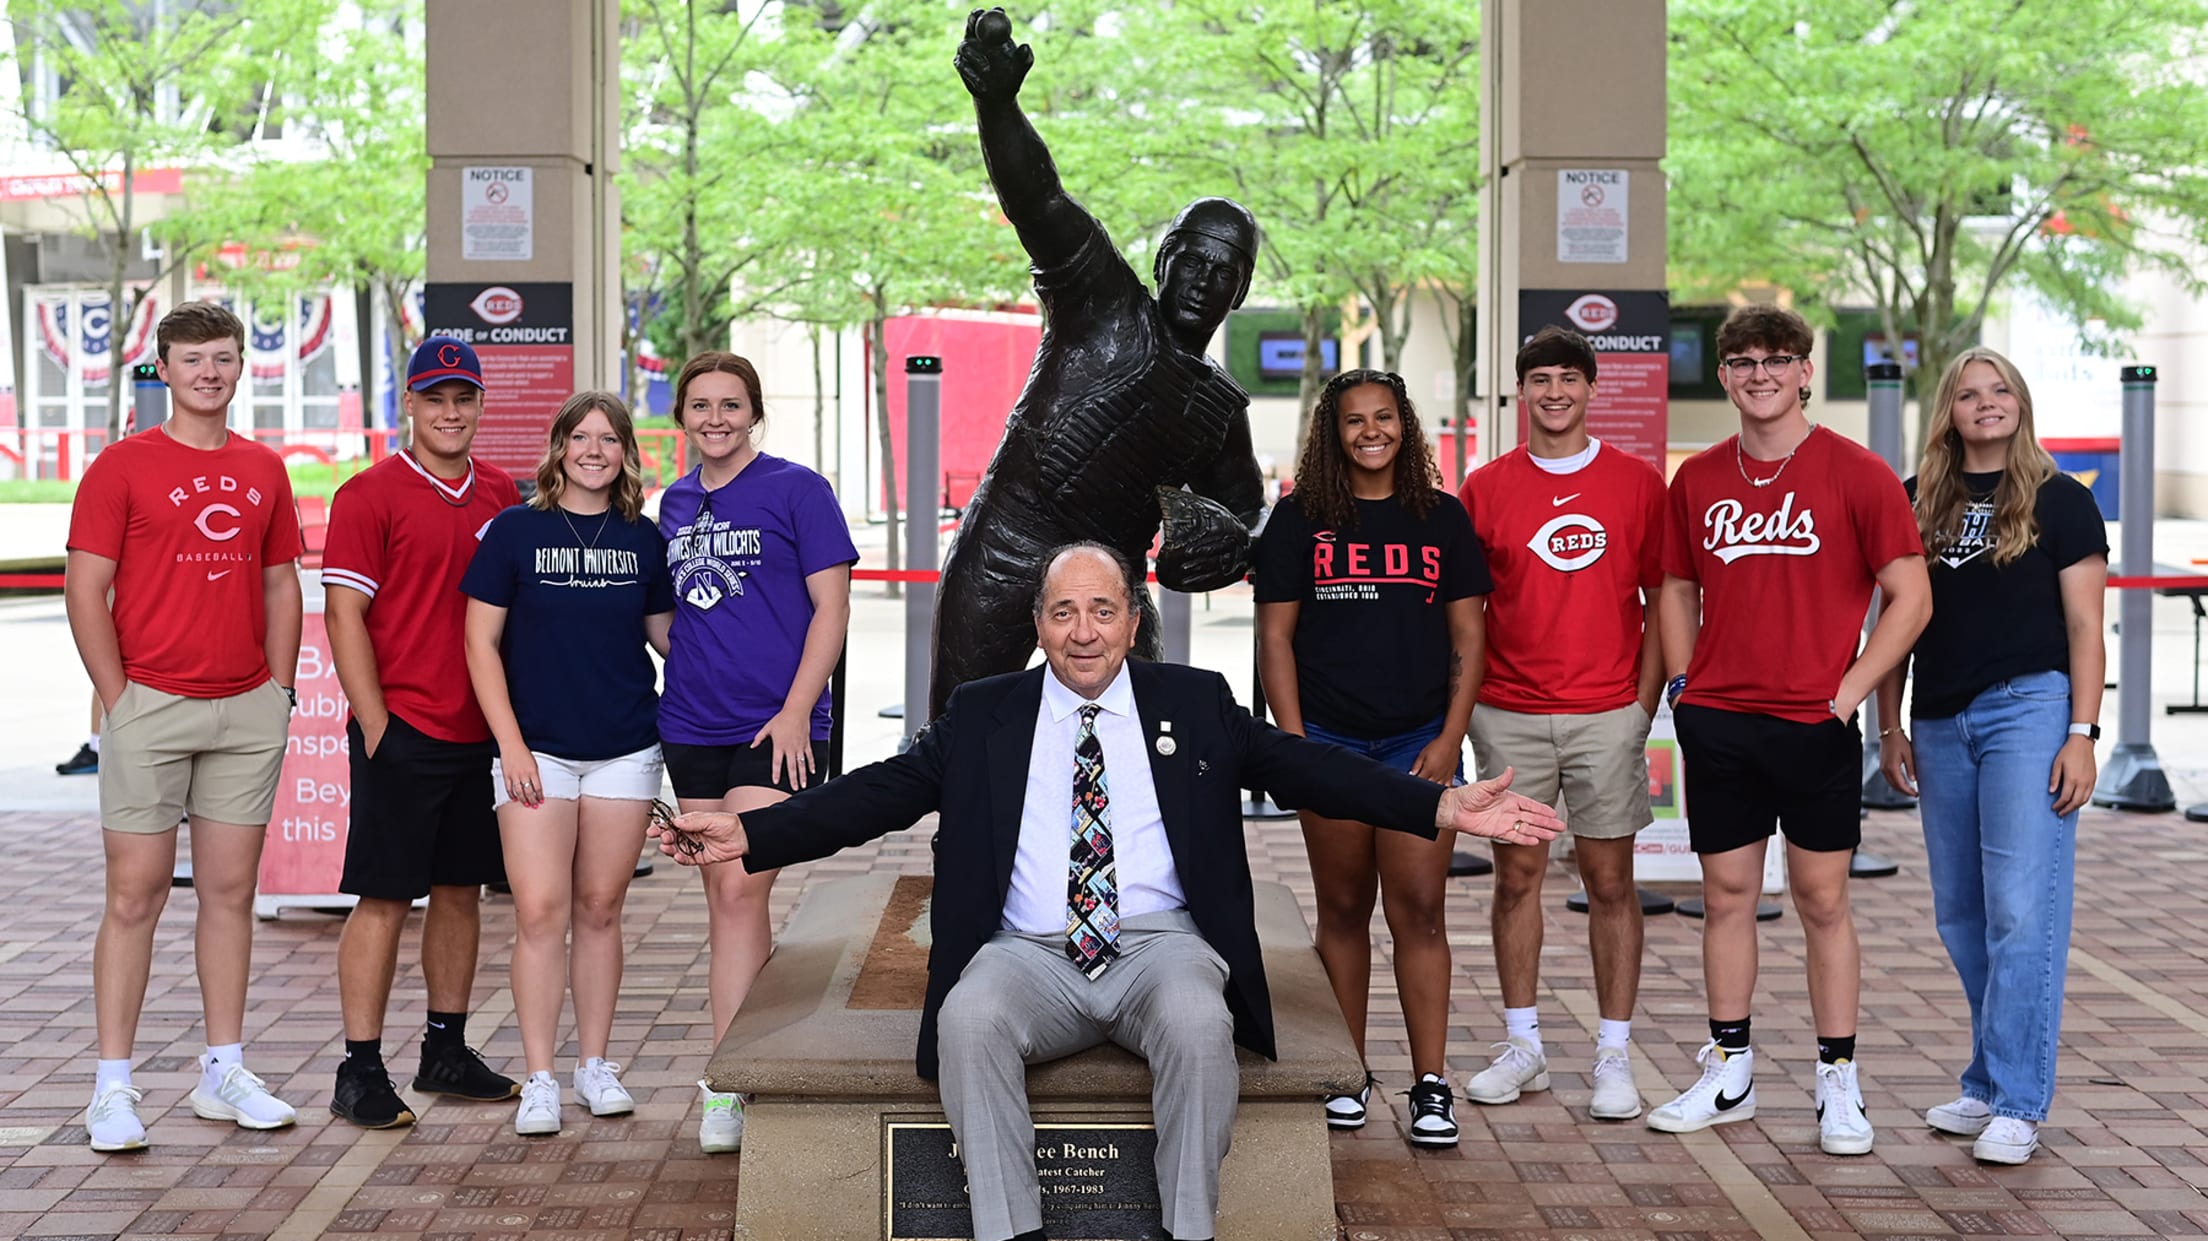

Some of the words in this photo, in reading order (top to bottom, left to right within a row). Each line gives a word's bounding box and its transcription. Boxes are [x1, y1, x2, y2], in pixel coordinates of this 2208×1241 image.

[470, 169, 524, 182] NOTICE
[1566, 172, 1620, 184] NOTICE
[490, 328, 568, 342] CONDUCT
[168, 475, 262, 507] REDS
[1703, 491, 1821, 566] Reds
[713, 529, 760, 556] WILDCATS
[1551, 533, 1607, 553] REDS
[176, 552, 243, 562] BASEBALL
[535, 547, 580, 574] BELMONT
[584, 548, 639, 575] UNIVERSITY
[1314, 543, 1440, 581] REDS
[296, 778, 351, 807] Bey
[282, 816, 337, 842] this
[1036, 1146, 1057, 1159] ee
[1063, 1143, 1120, 1159] Bench
[1065, 1167, 1105, 1177] Catcher
[1053, 1185, 1104, 1194] 1967-1983
